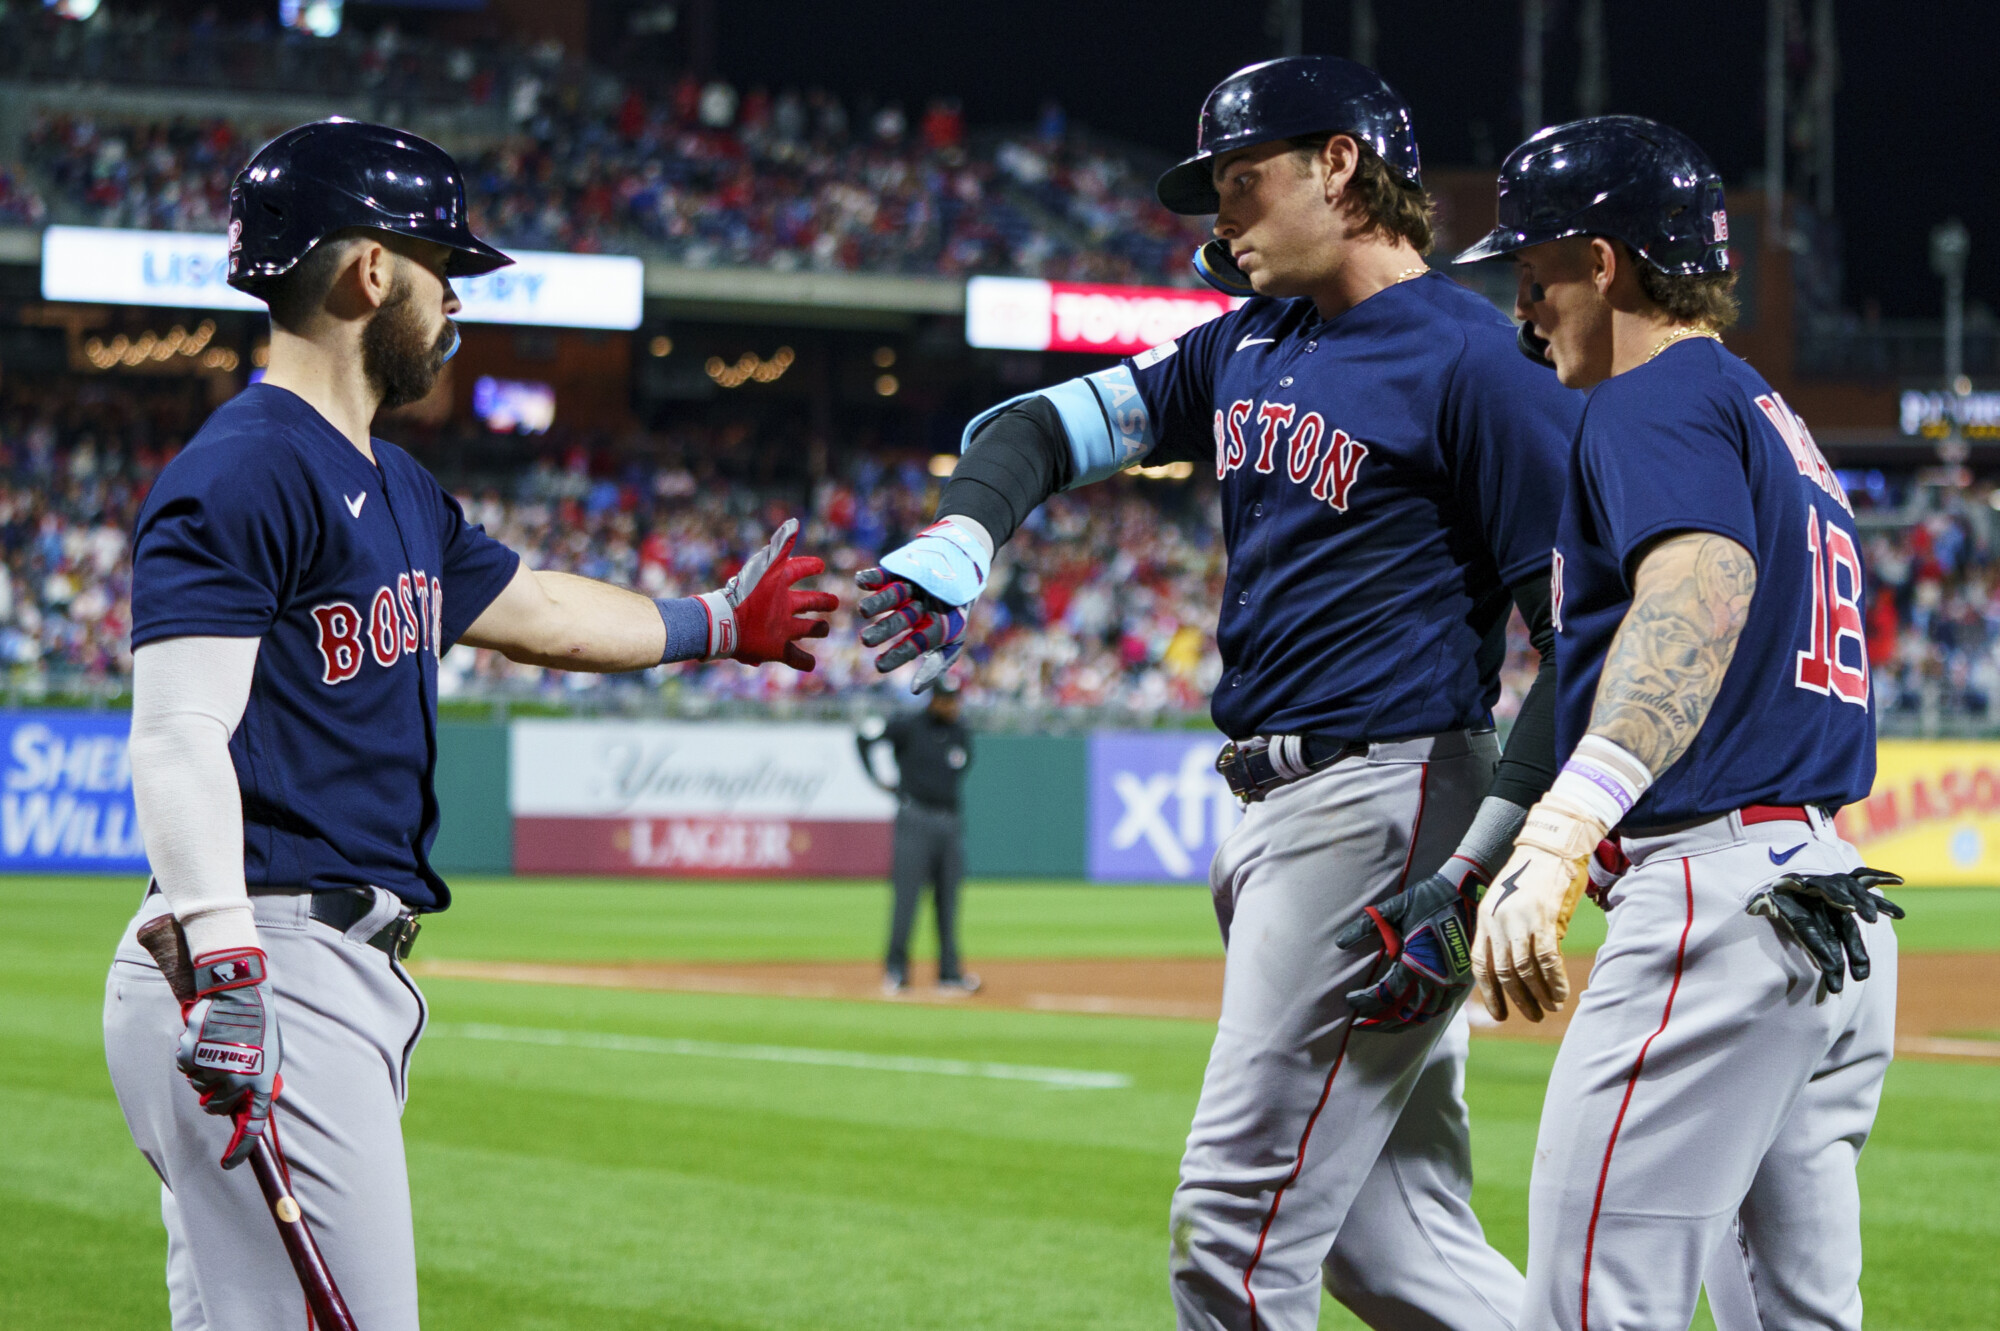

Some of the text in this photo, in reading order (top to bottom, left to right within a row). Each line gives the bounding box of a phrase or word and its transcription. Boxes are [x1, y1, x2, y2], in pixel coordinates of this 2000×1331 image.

[1097, 366, 1148, 464] CASA
[1214, 398, 1369, 512] OSTON
[310, 569, 442, 685] BOSTO
[594, 736, 830, 814] Yuengling
[631, 819, 792, 868] LAGER
